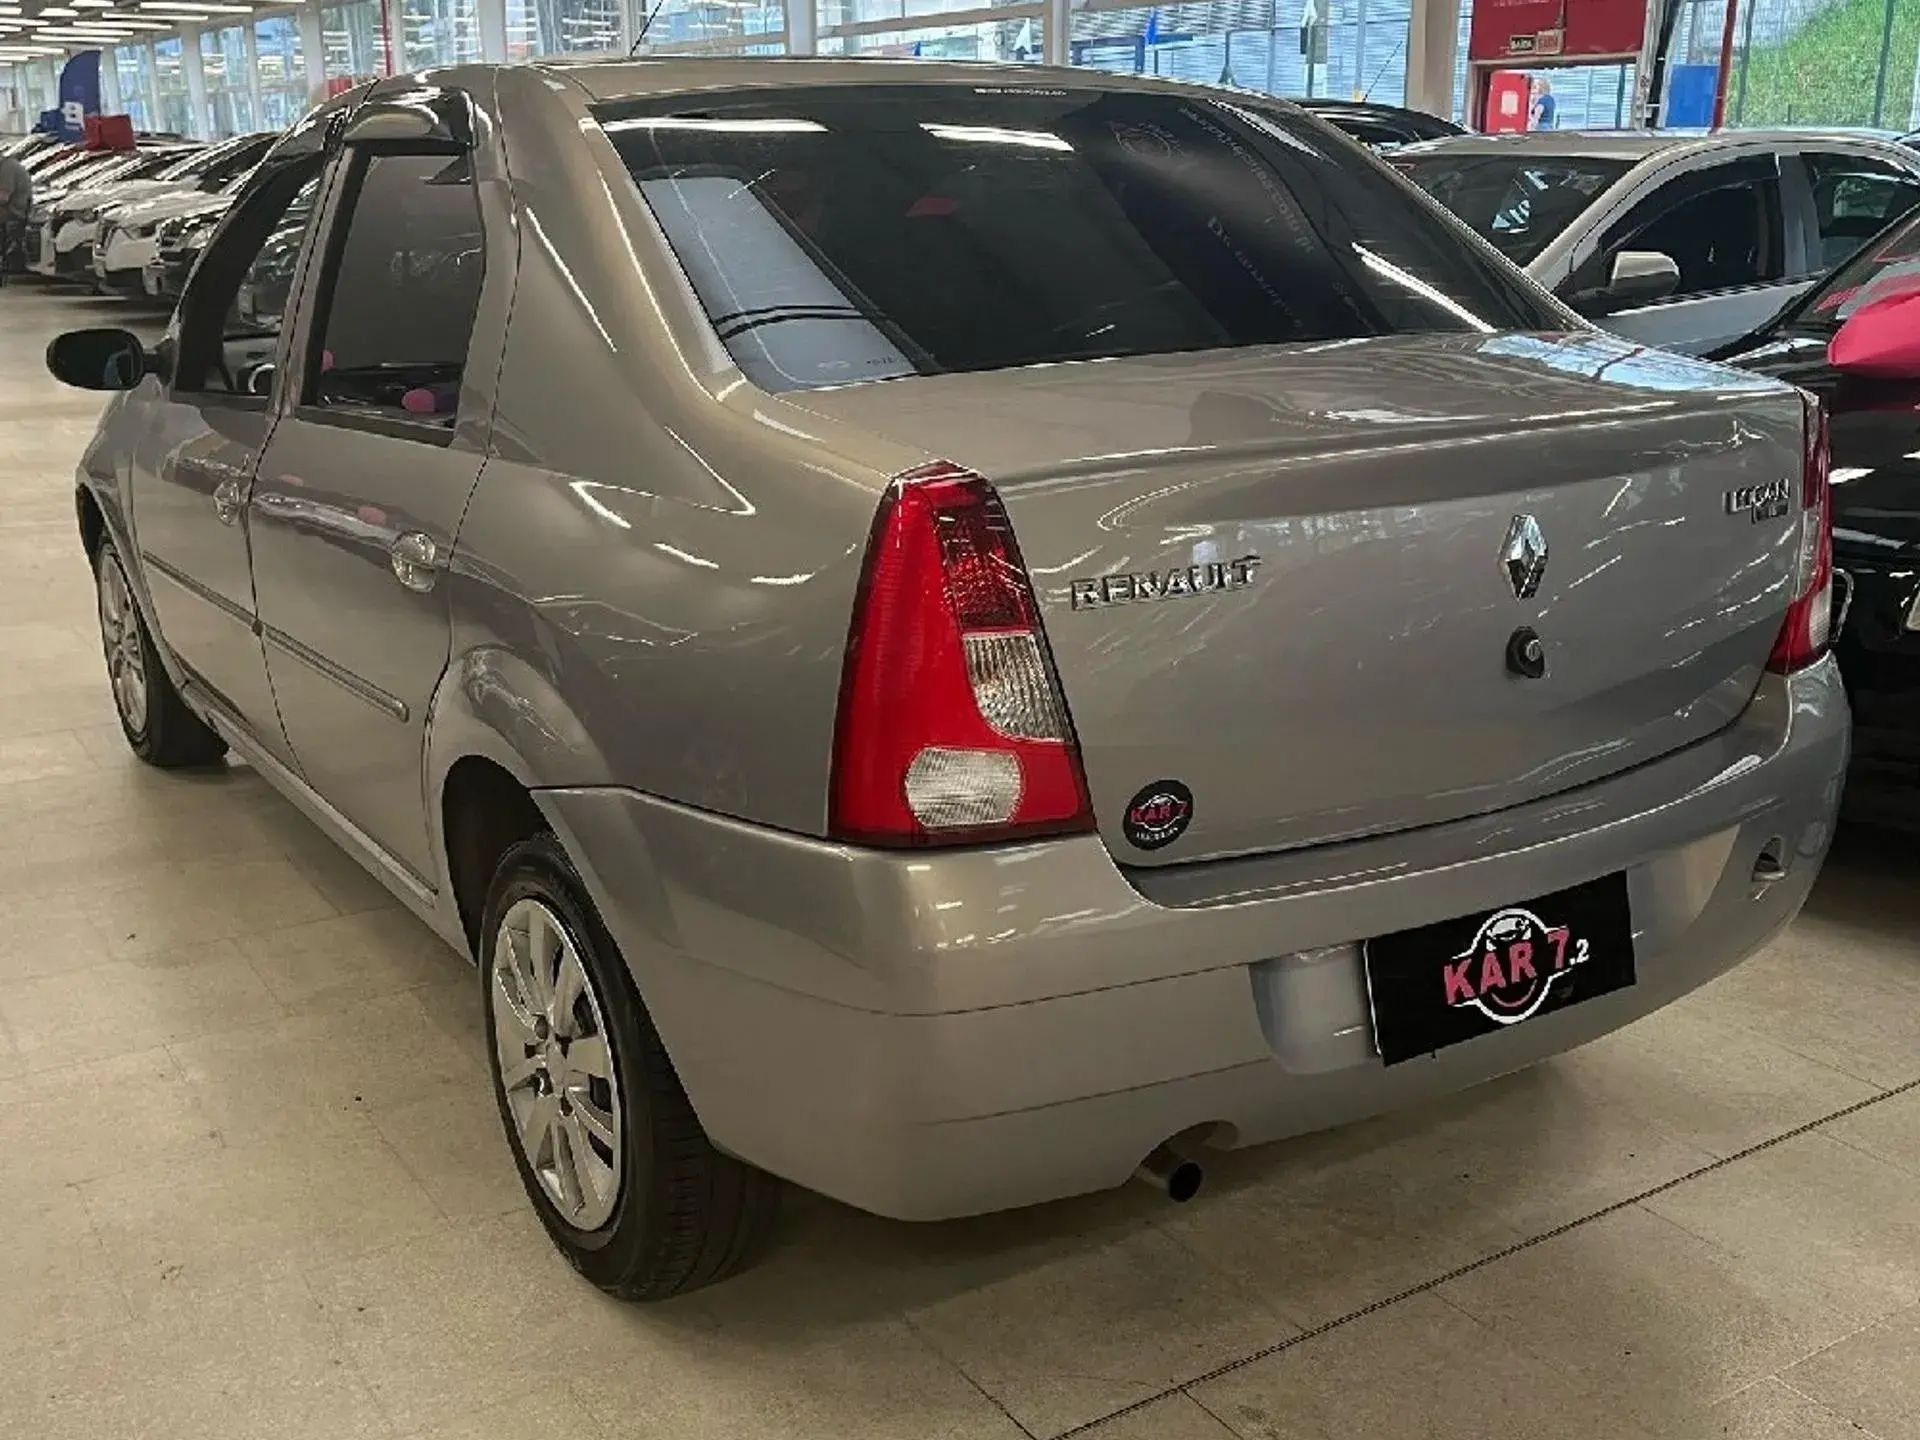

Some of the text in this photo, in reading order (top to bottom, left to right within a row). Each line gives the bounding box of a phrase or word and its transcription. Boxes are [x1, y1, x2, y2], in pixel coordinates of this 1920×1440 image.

[1071, 555, 1262, 611] RENAULT
[1131, 804, 1171, 823] KAR
[1443, 942, 1538, 1005] KAR
